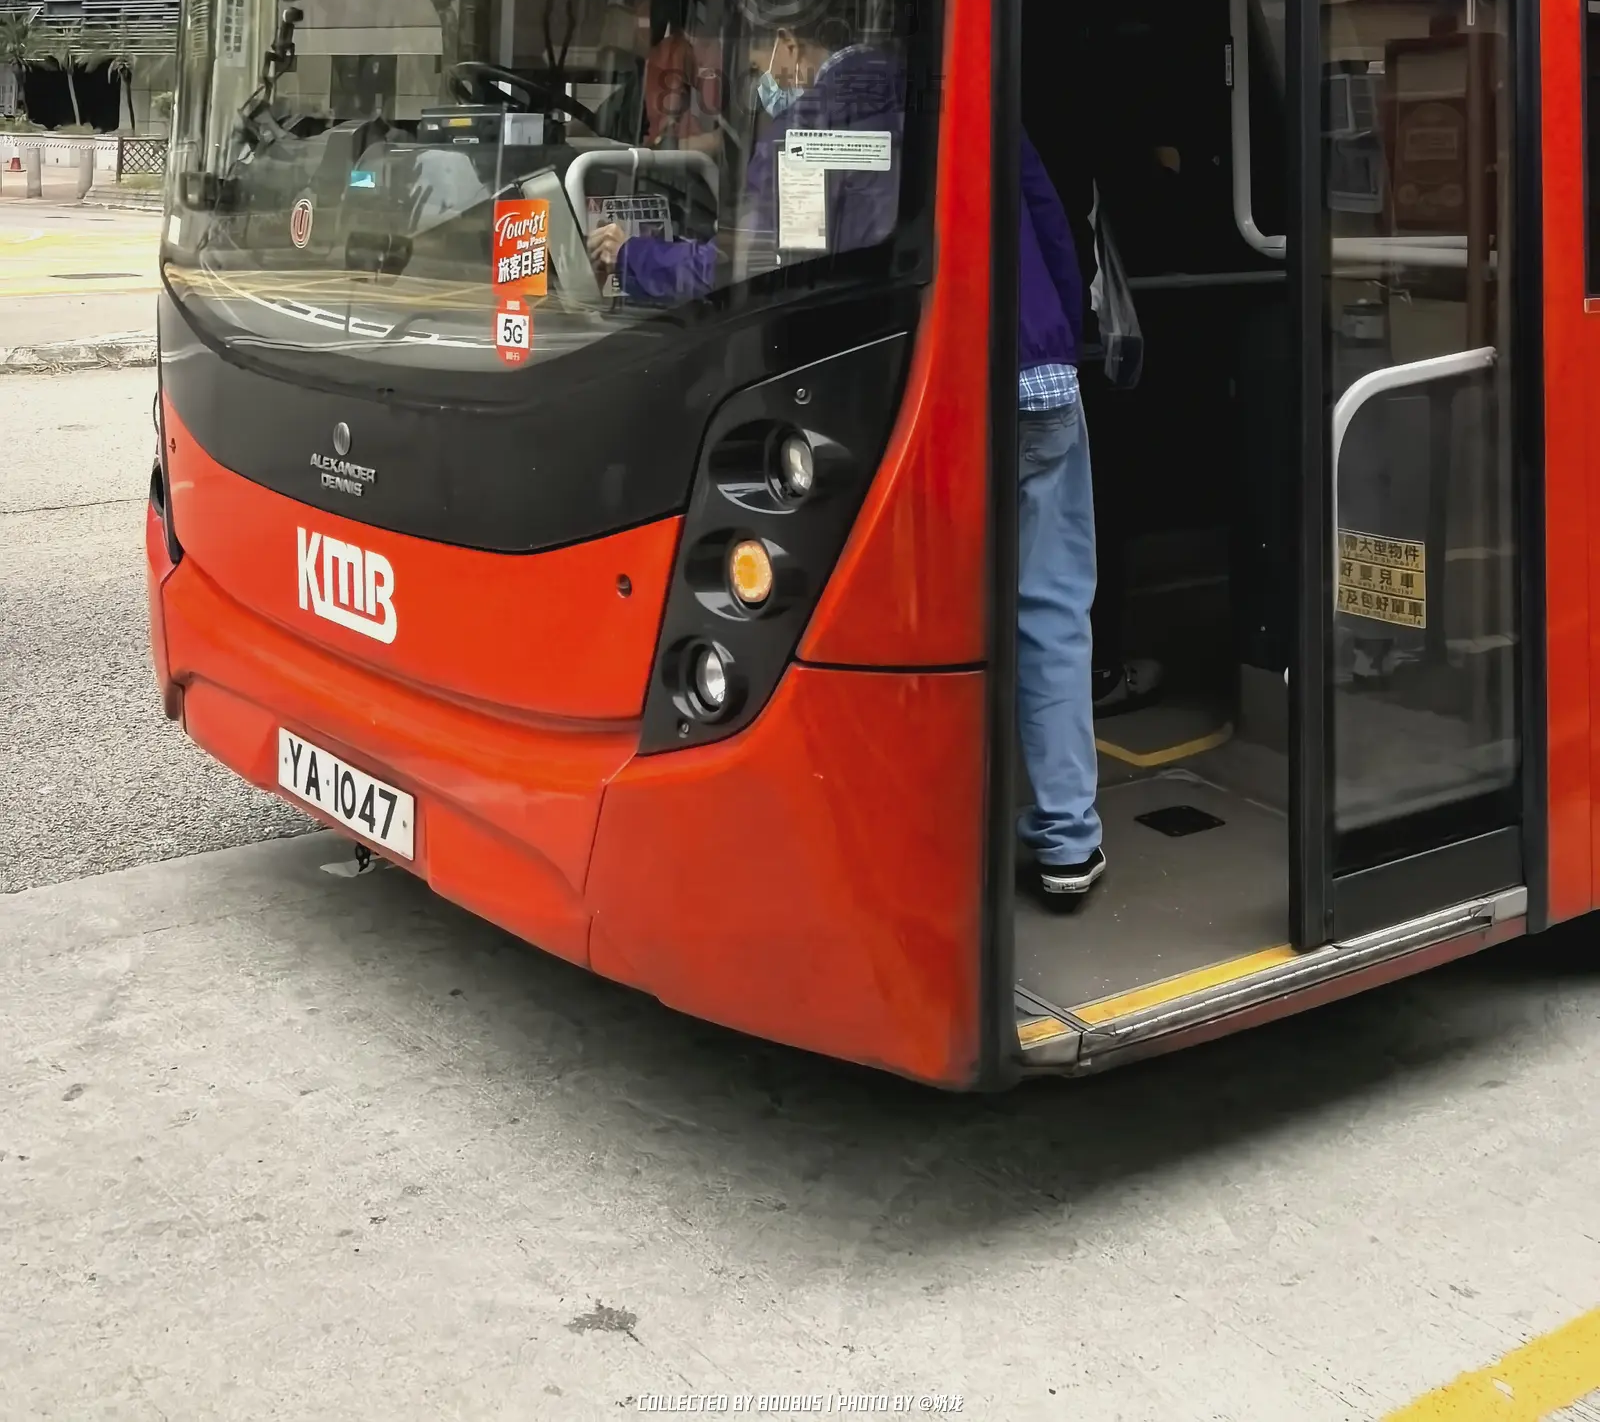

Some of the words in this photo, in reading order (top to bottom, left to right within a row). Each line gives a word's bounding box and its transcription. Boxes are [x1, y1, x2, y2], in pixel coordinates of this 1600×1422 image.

[495, 209, 546, 247] Tourist
[516, 238, 529, 250] Day
[530, 236, 546, 248] Pass
[497, 246, 546, 283] 旅客日票
[503, 318, 523, 344] 5G
[310, 453, 376, 483] ALEXANDER
[321, 473, 363, 497] DENNIS
[297, 526, 398, 644] KMB
[288, 738, 321, 801] YA
[334, 763, 398, 840] 1047
